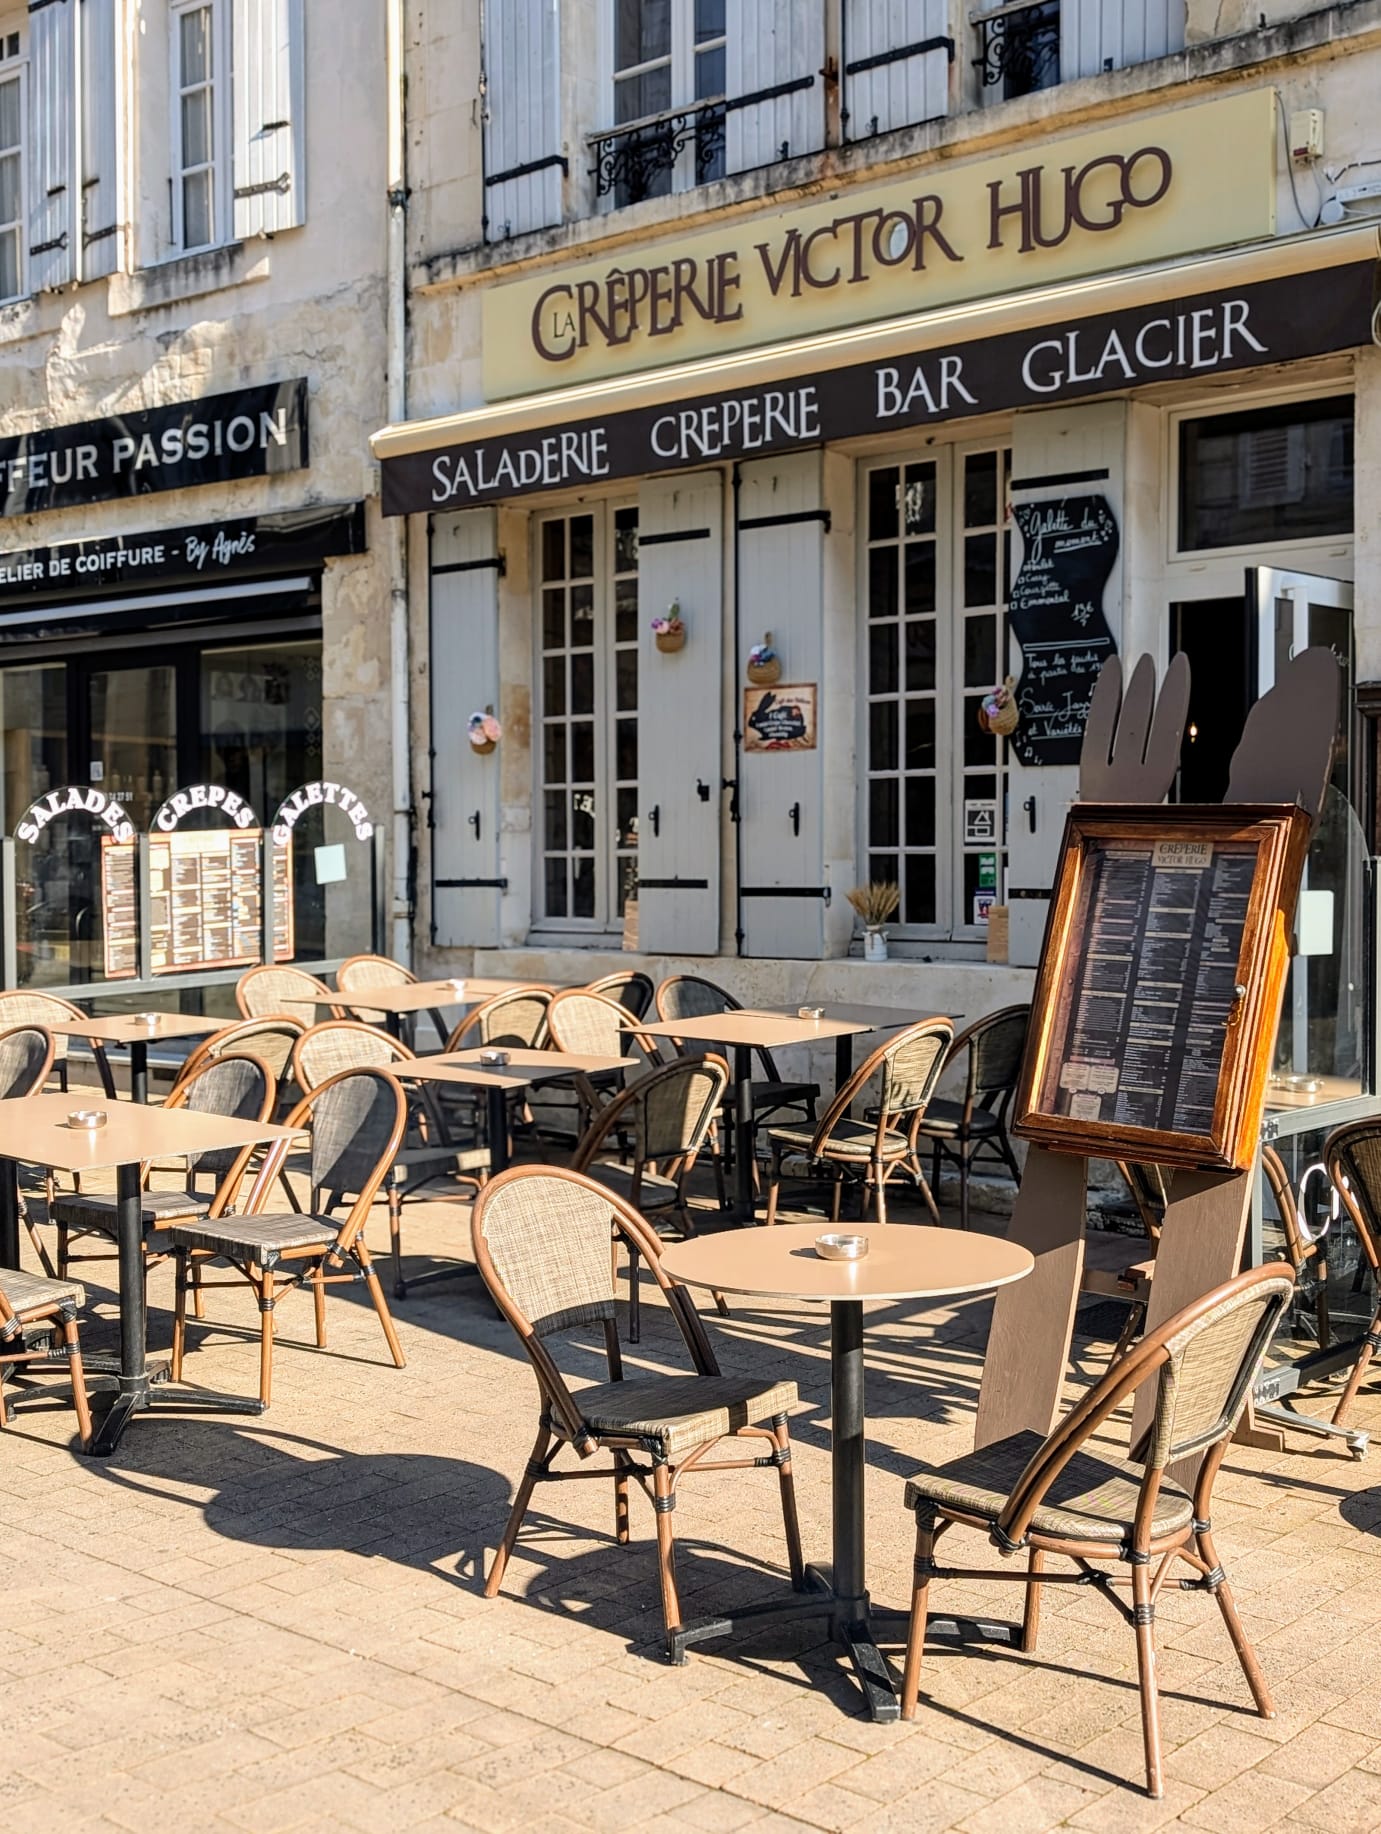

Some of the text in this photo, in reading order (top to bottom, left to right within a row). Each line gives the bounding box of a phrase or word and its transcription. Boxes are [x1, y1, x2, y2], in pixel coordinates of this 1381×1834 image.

[531, 146, 1172, 361] LA CRÊPERIE VICTOR HUGO
[431, 300, 1268, 502] SALADERIE CREPERIE BAR GLACIER
[113, 408, 287, 473] PASSION
[50, 558, 71, 577] DE
[76, 545, 165, 573] COIFFURE
[185, 536, 209, 569] By
[212, 531, 256, 566] Agnès
[18, 786, 134, 844] SALADES
[157, 785, 254, 832] CREPES
[272, 782, 374, 846] GALETTES
